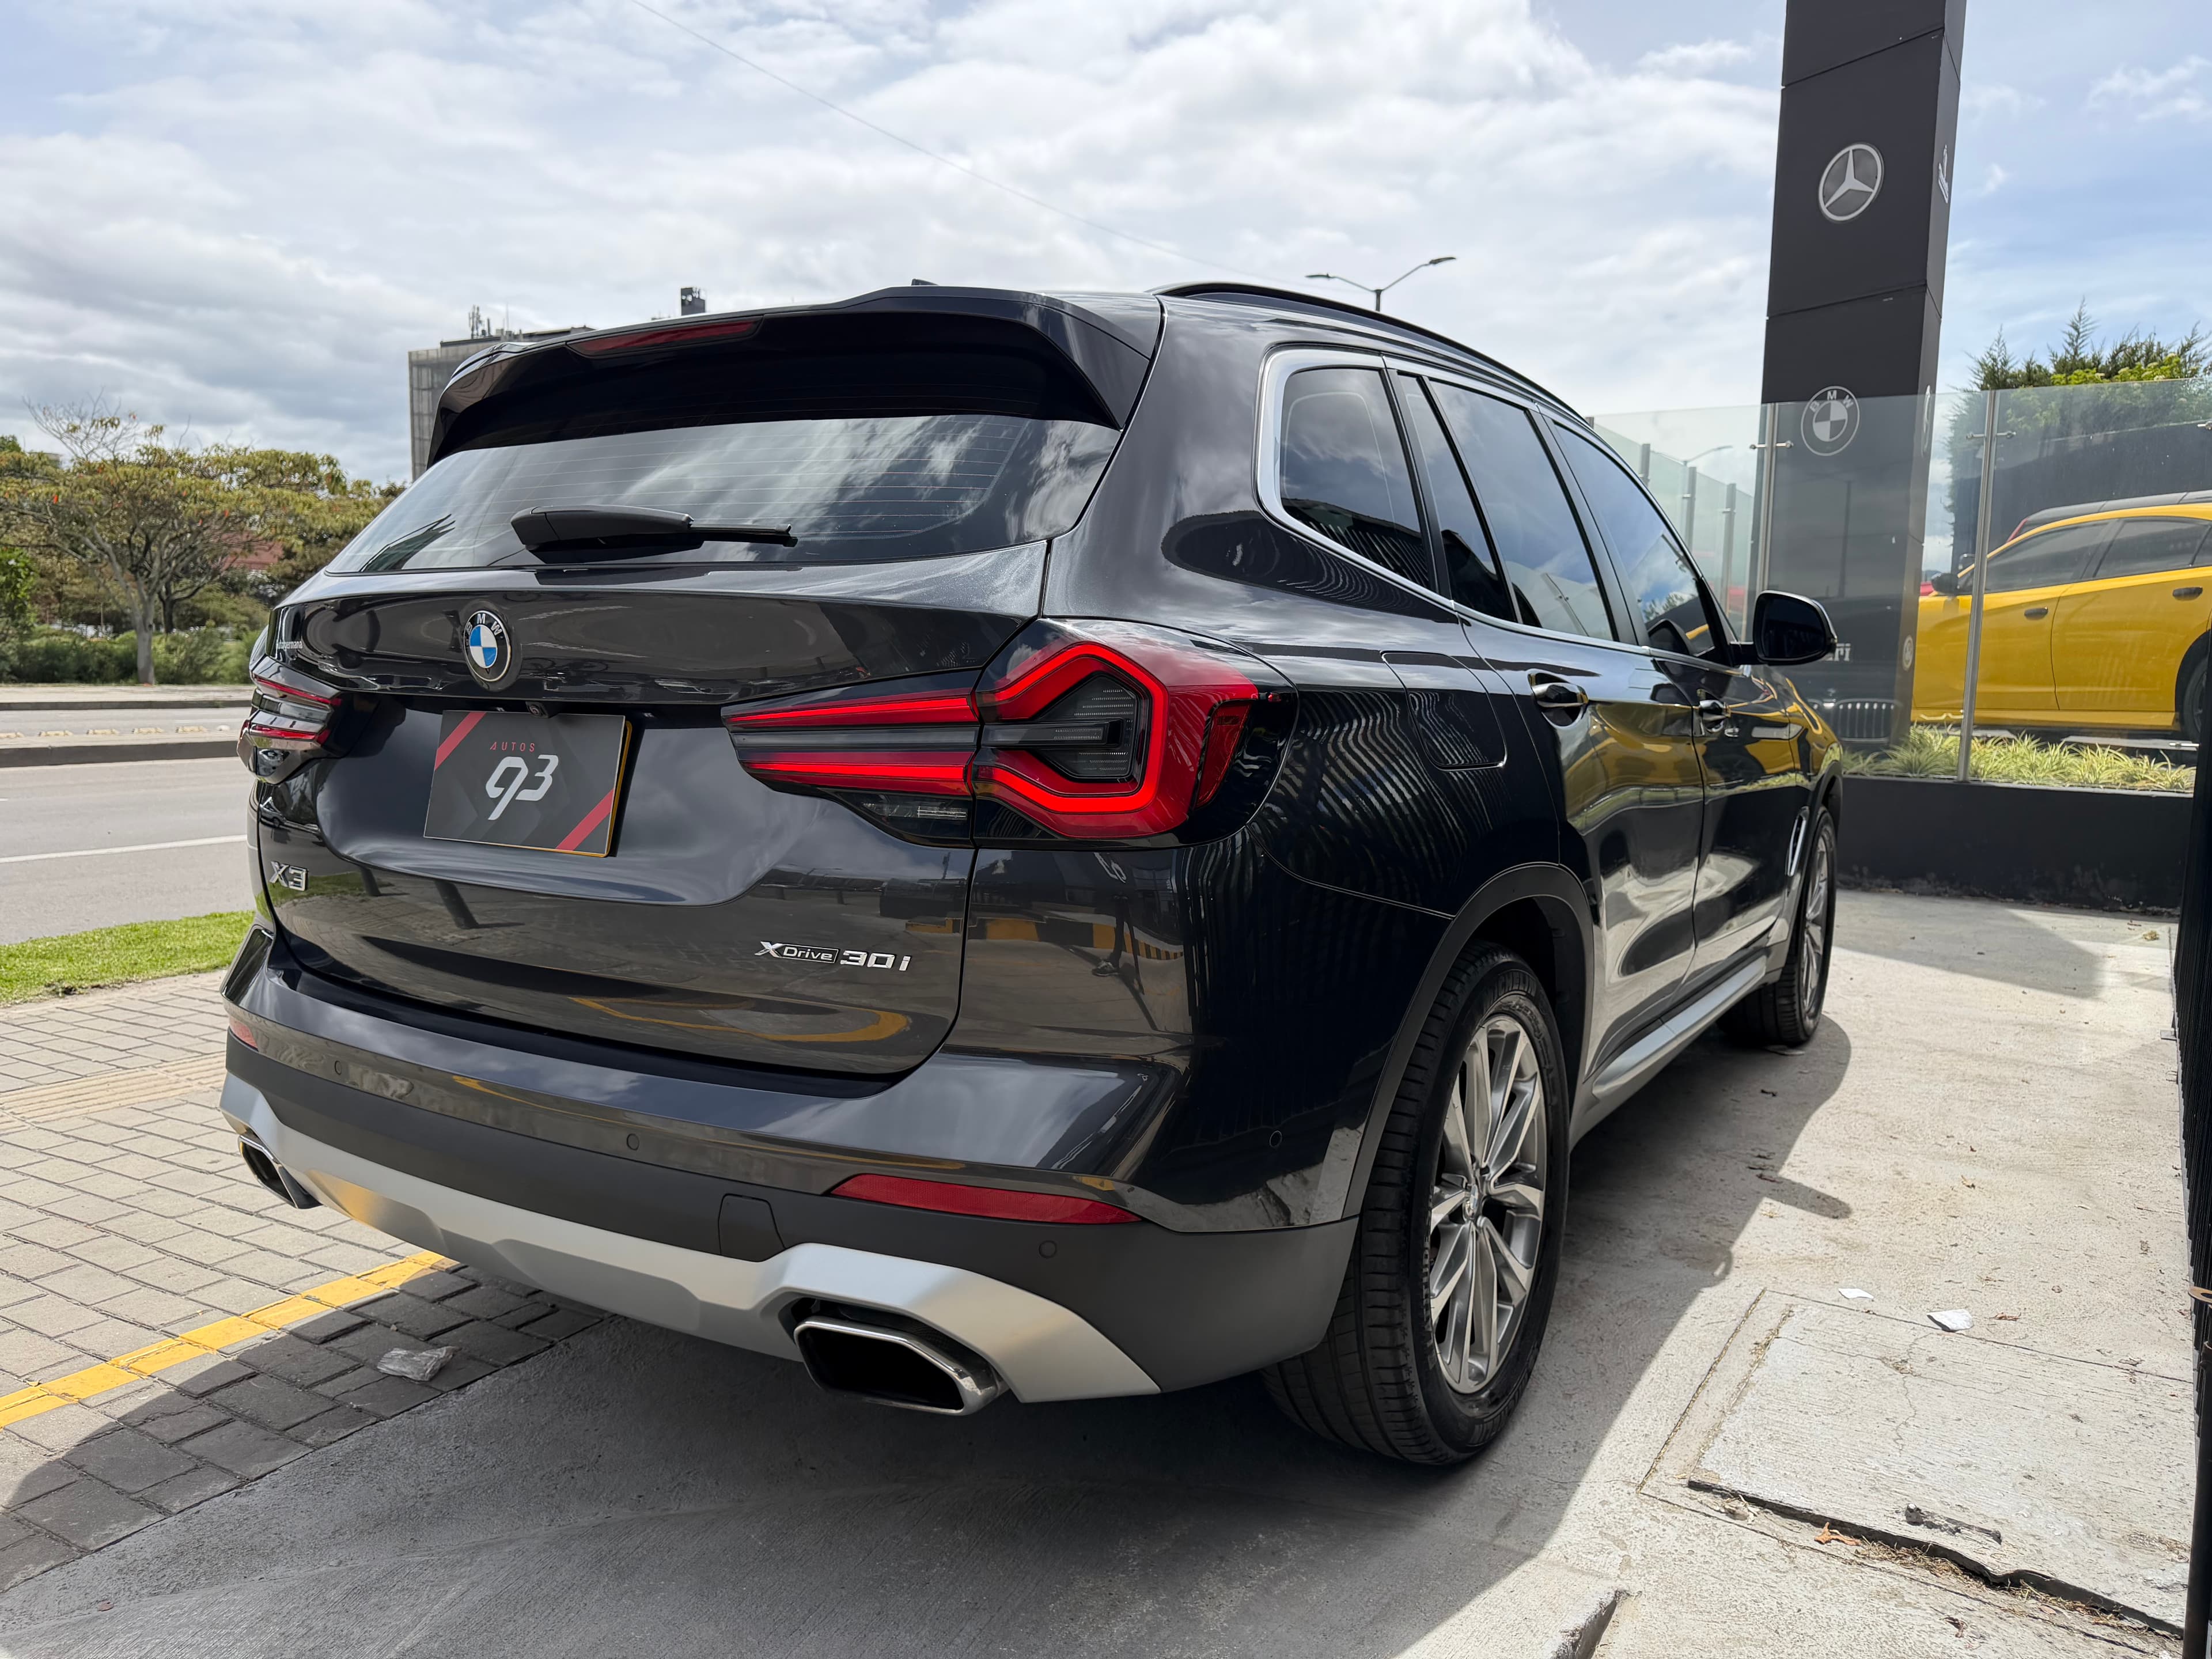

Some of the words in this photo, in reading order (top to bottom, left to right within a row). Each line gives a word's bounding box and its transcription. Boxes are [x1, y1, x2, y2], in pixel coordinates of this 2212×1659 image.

[1809, 389, 1854, 413] BMW
[466, 613, 502, 636] BMW
[490, 741, 535, 752] AUTOS
[485, 754, 559, 821] 93
[268, 861, 307, 892] X3
[840, 950, 911, 971] 30i
